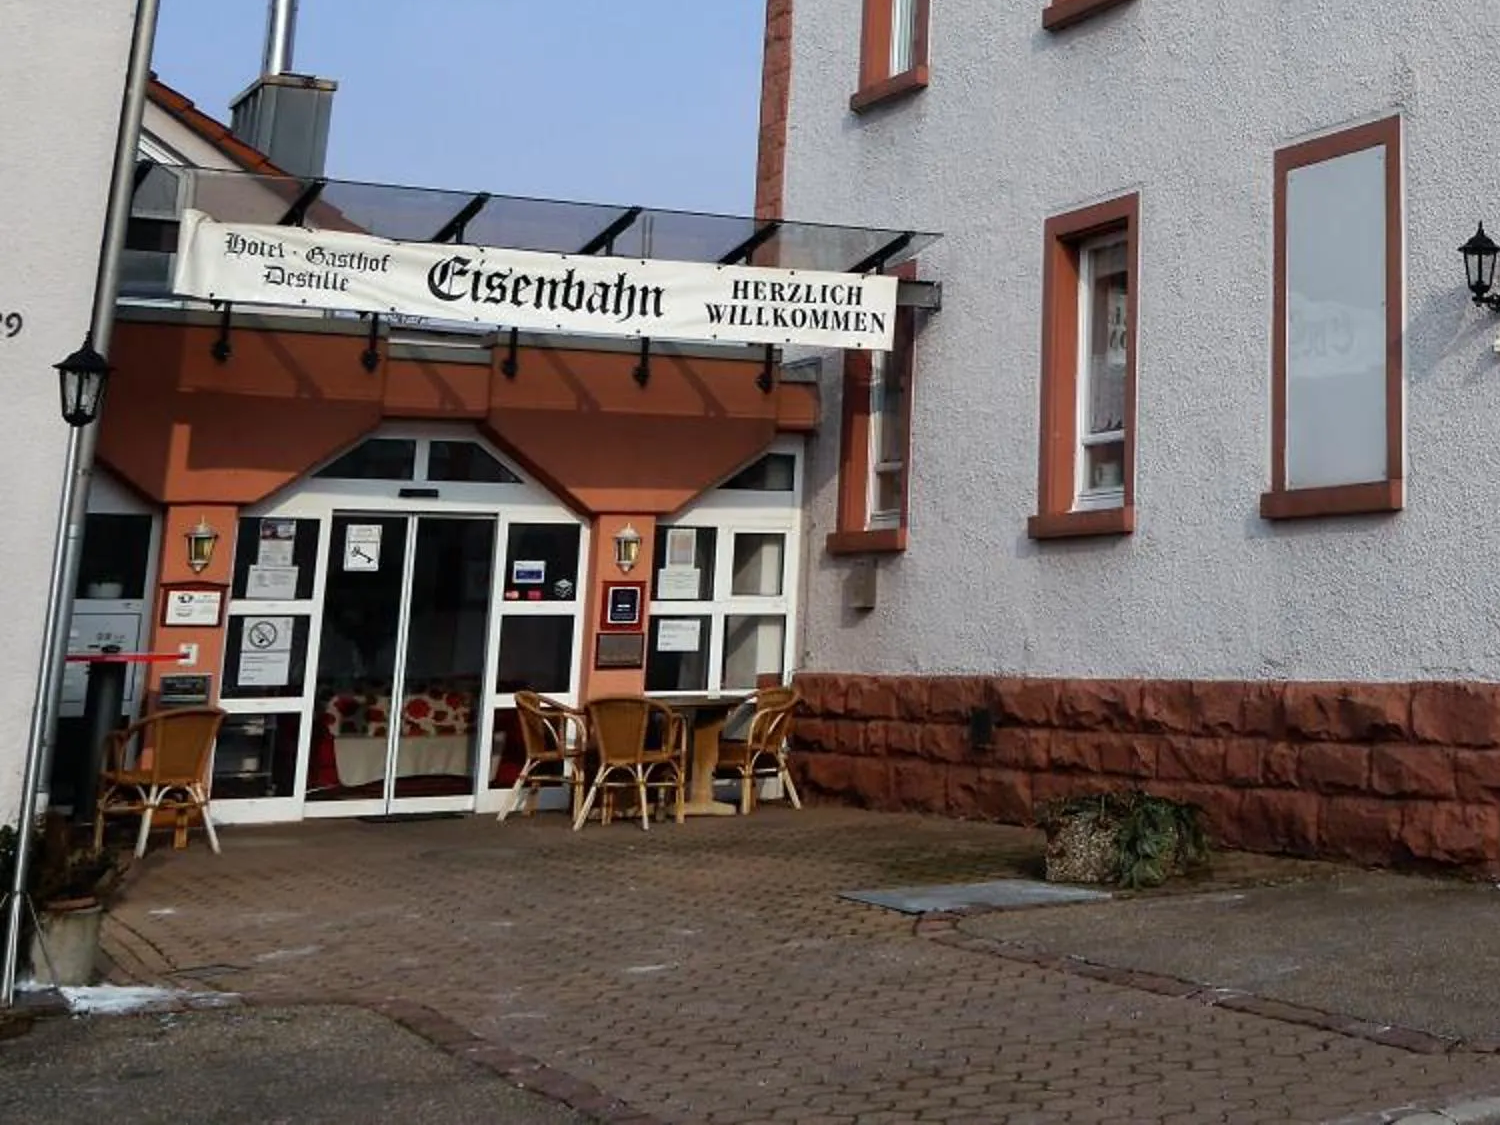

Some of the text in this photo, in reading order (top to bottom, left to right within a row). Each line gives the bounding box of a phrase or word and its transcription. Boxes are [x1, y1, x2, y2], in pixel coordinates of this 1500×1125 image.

[224, 232, 391, 273] Hotel Gasthof
[263, 264, 350, 292] Destille
[427, 254, 666, 323] Eisenbahn
[731, 279, 864, 306] HERZLICH
[705, 302, 887, 334] WILLKOMMEN
